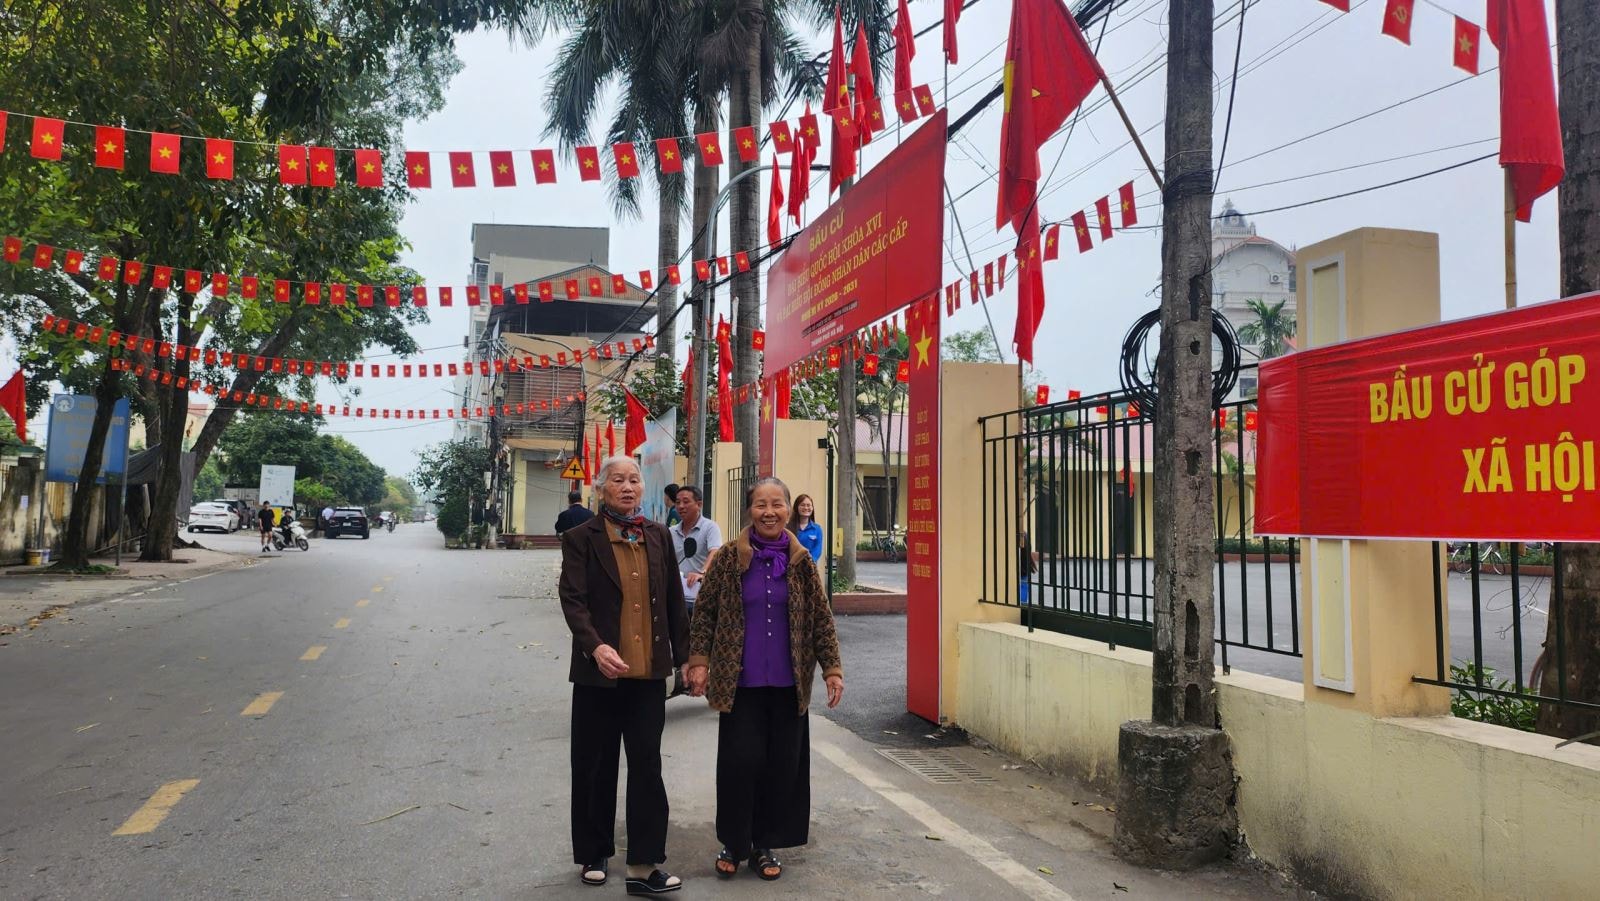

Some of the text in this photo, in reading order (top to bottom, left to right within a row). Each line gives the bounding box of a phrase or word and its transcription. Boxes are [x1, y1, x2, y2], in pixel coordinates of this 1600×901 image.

[866, 211, 882, 237] XVI
[871, 233, 888, 257] CÁC
[889, 216, 908, 244] CẤP
[1369, 347, 1586, 424] BẦU CỬ GÓP
[1462, 431, 1596, 503] XÃ HỘI
